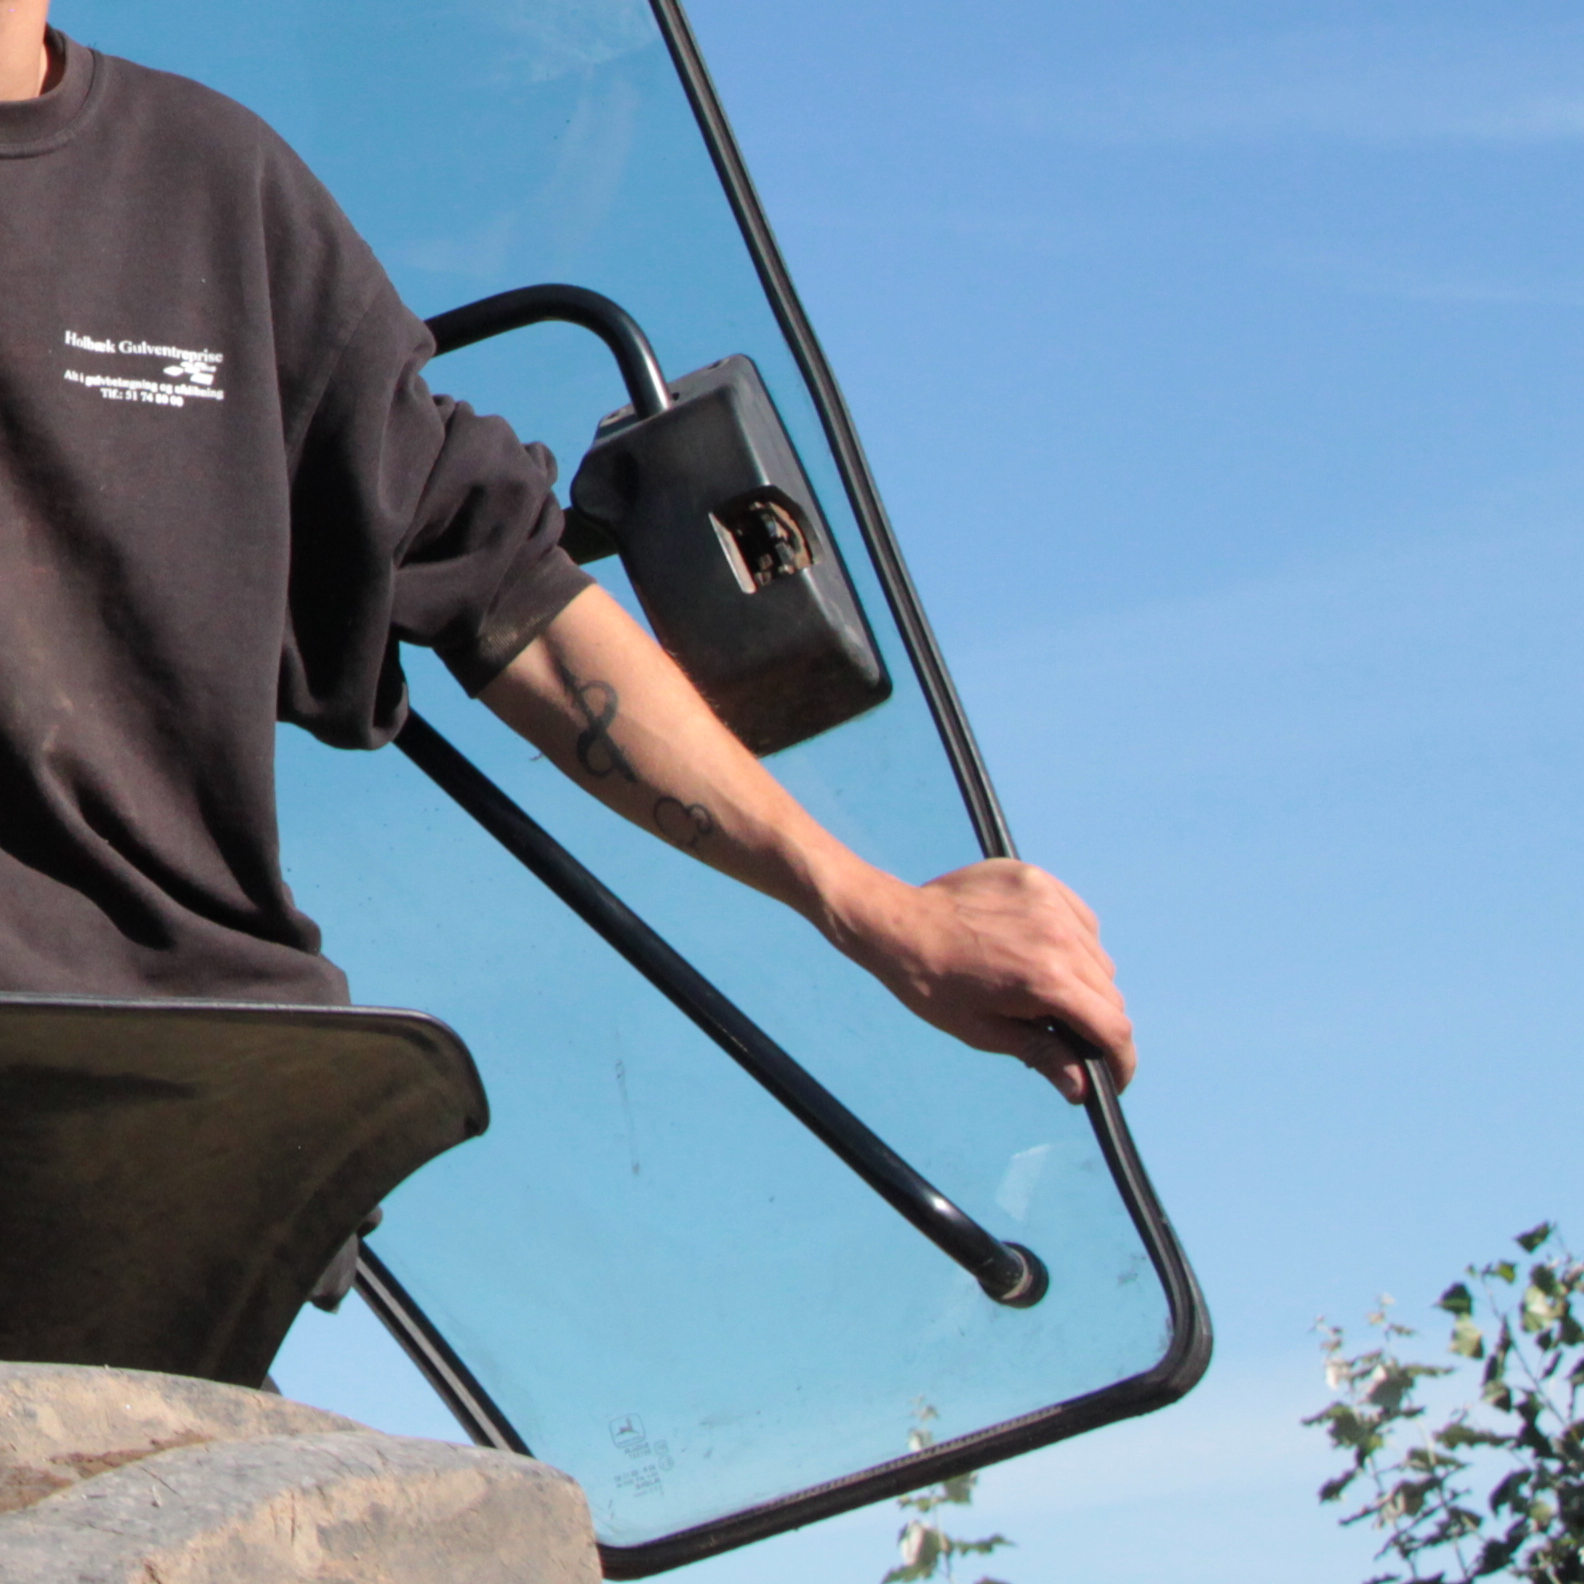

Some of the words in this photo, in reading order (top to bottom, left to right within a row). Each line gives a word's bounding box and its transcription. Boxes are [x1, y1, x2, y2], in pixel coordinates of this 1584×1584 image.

[64, 330, 116, 354] Holbæk
[118, 340, 223, 363] Gulventreprise
[160, 382, 173, 395] og
